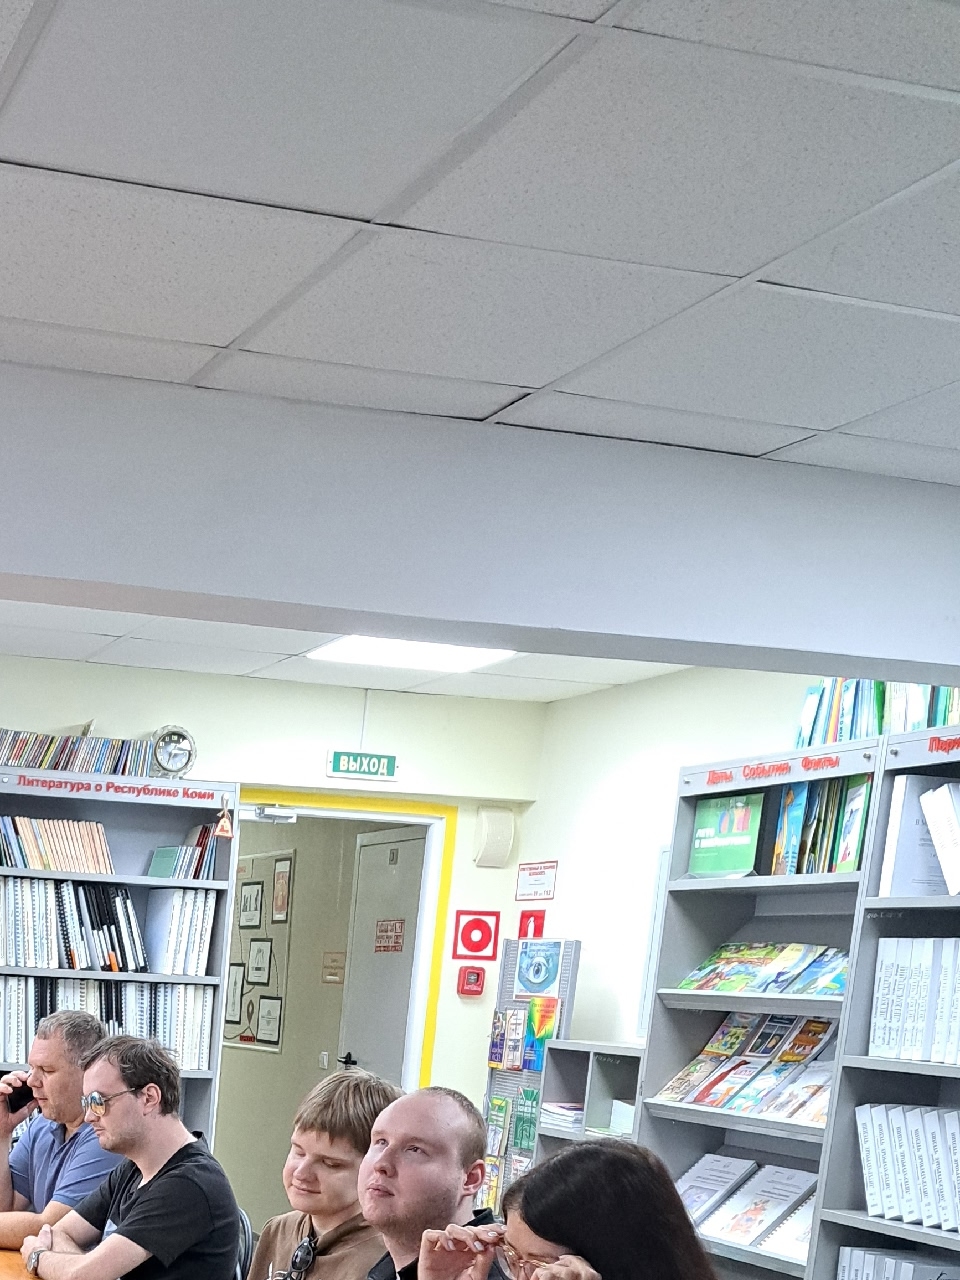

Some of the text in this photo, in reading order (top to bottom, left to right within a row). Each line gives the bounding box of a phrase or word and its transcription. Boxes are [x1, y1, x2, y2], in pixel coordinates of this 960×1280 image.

[339, 755, 388, 776] ВЫХОД
[17, 775, 215, 800] Литература о Республике Коми
